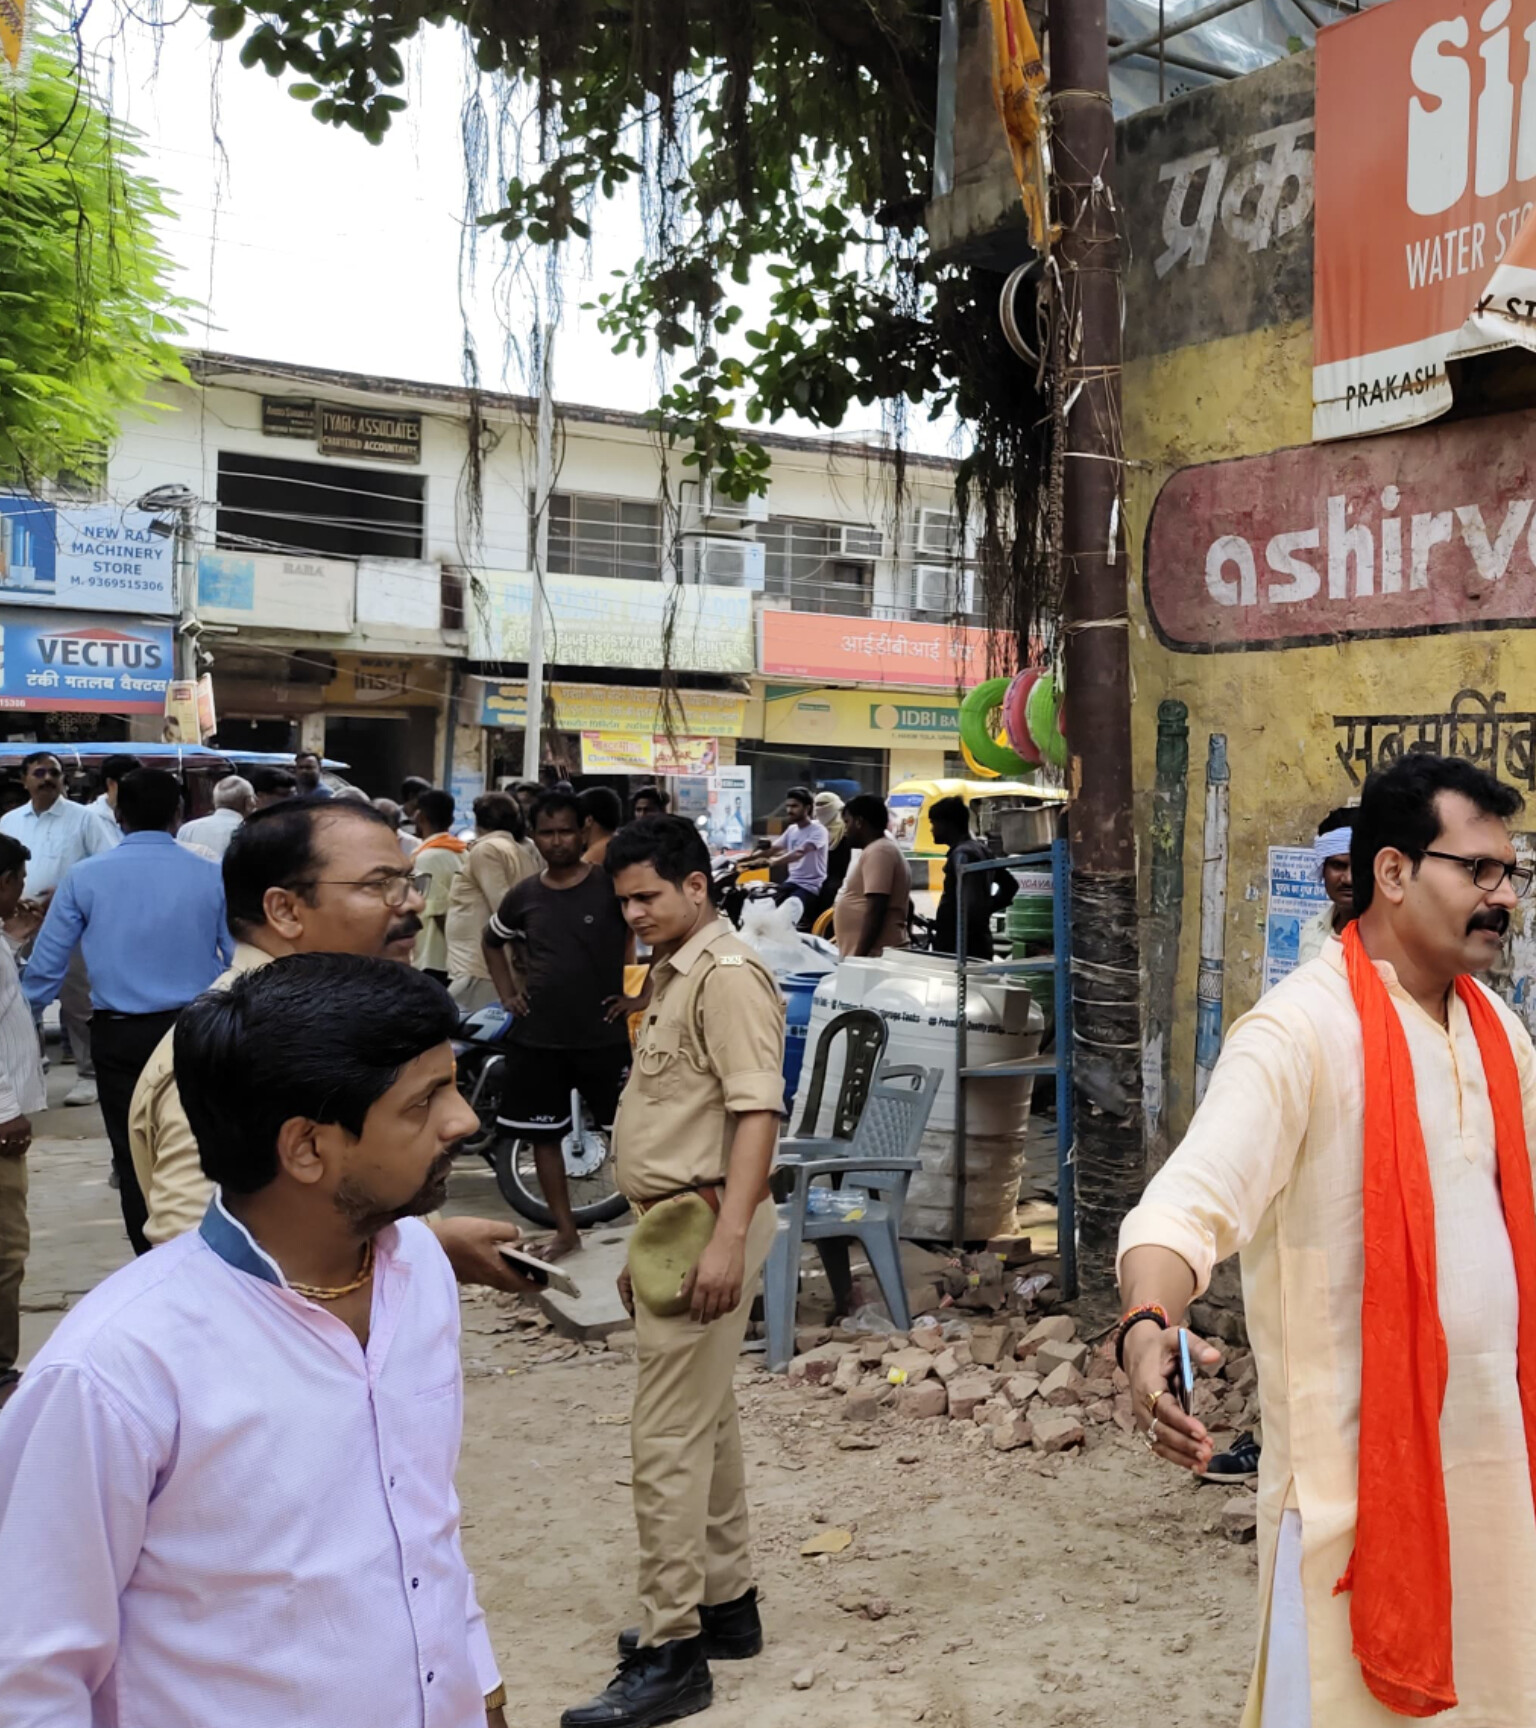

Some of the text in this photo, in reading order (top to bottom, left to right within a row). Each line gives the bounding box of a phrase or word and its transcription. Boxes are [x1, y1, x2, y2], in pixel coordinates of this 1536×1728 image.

[1154, 117, 1315, 280] प्रक
[1406, 222, 1485, 290] WATER
[1345, 364, 1438, 411] PRAKASH
[323, 412, 351, 433] TYAGI
[357, 418, 420, 440] ASSOCIATES
[322, 436, 418, 455] CHARTERED ACCOUNTANTS
[84, 526, 152, 542] NEW RAJ
[71, 542, 163, 561] MACHINERY
[93, 561, 142, 576] STORE
[70, 576, 164, 592] M. 9369515306
[37, 638, 163, 670] VECTUS
[842, 632, 941, 662] आईडीबीआई
[26, 669, 168, 692] टंकी मतलब वैक्टस
[901, 710, 960, 728] IDBI BA
